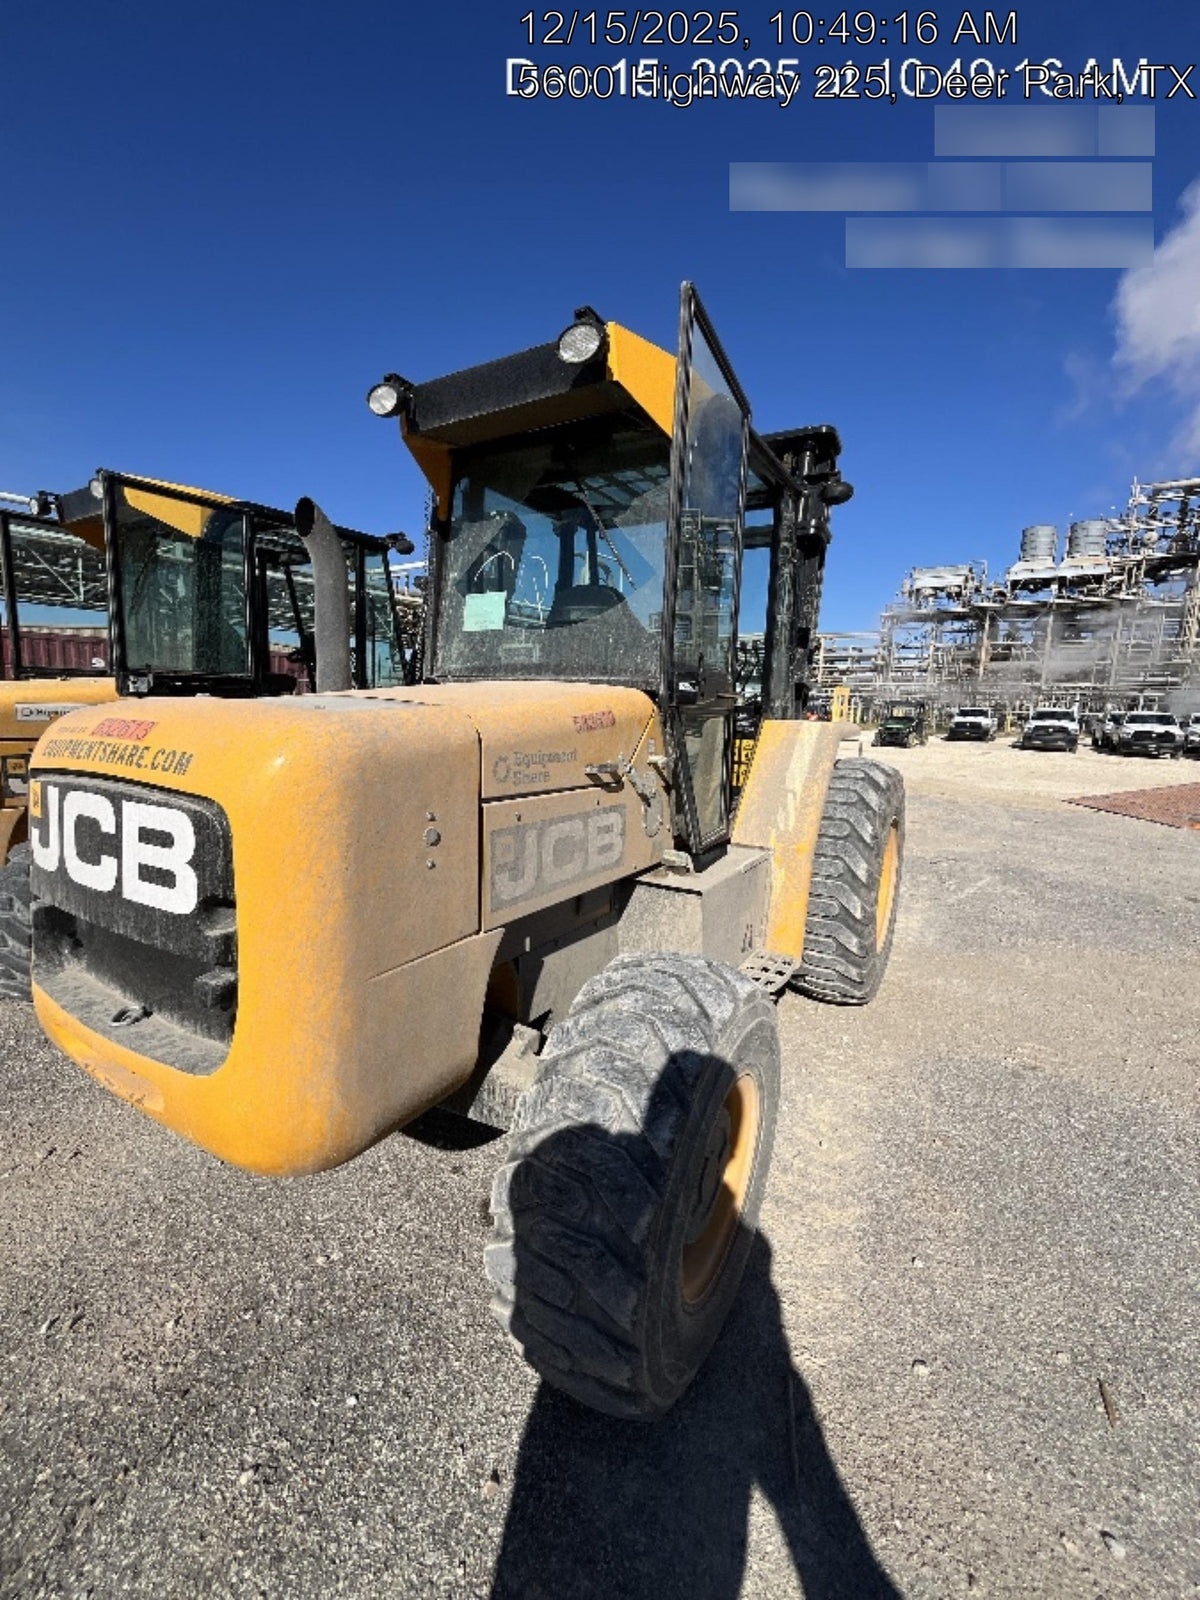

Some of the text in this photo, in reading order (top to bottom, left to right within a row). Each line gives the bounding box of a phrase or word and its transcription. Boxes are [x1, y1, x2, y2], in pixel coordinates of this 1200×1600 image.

[42, 739, 194, 776] EQUIPMENTSHARE.COM
[513, 748, 578, 769] Equipment
[513, 771, 551, 786] Share
[31, 786, 198, 916] JCB
[495, 811, 625, 900] JCB
